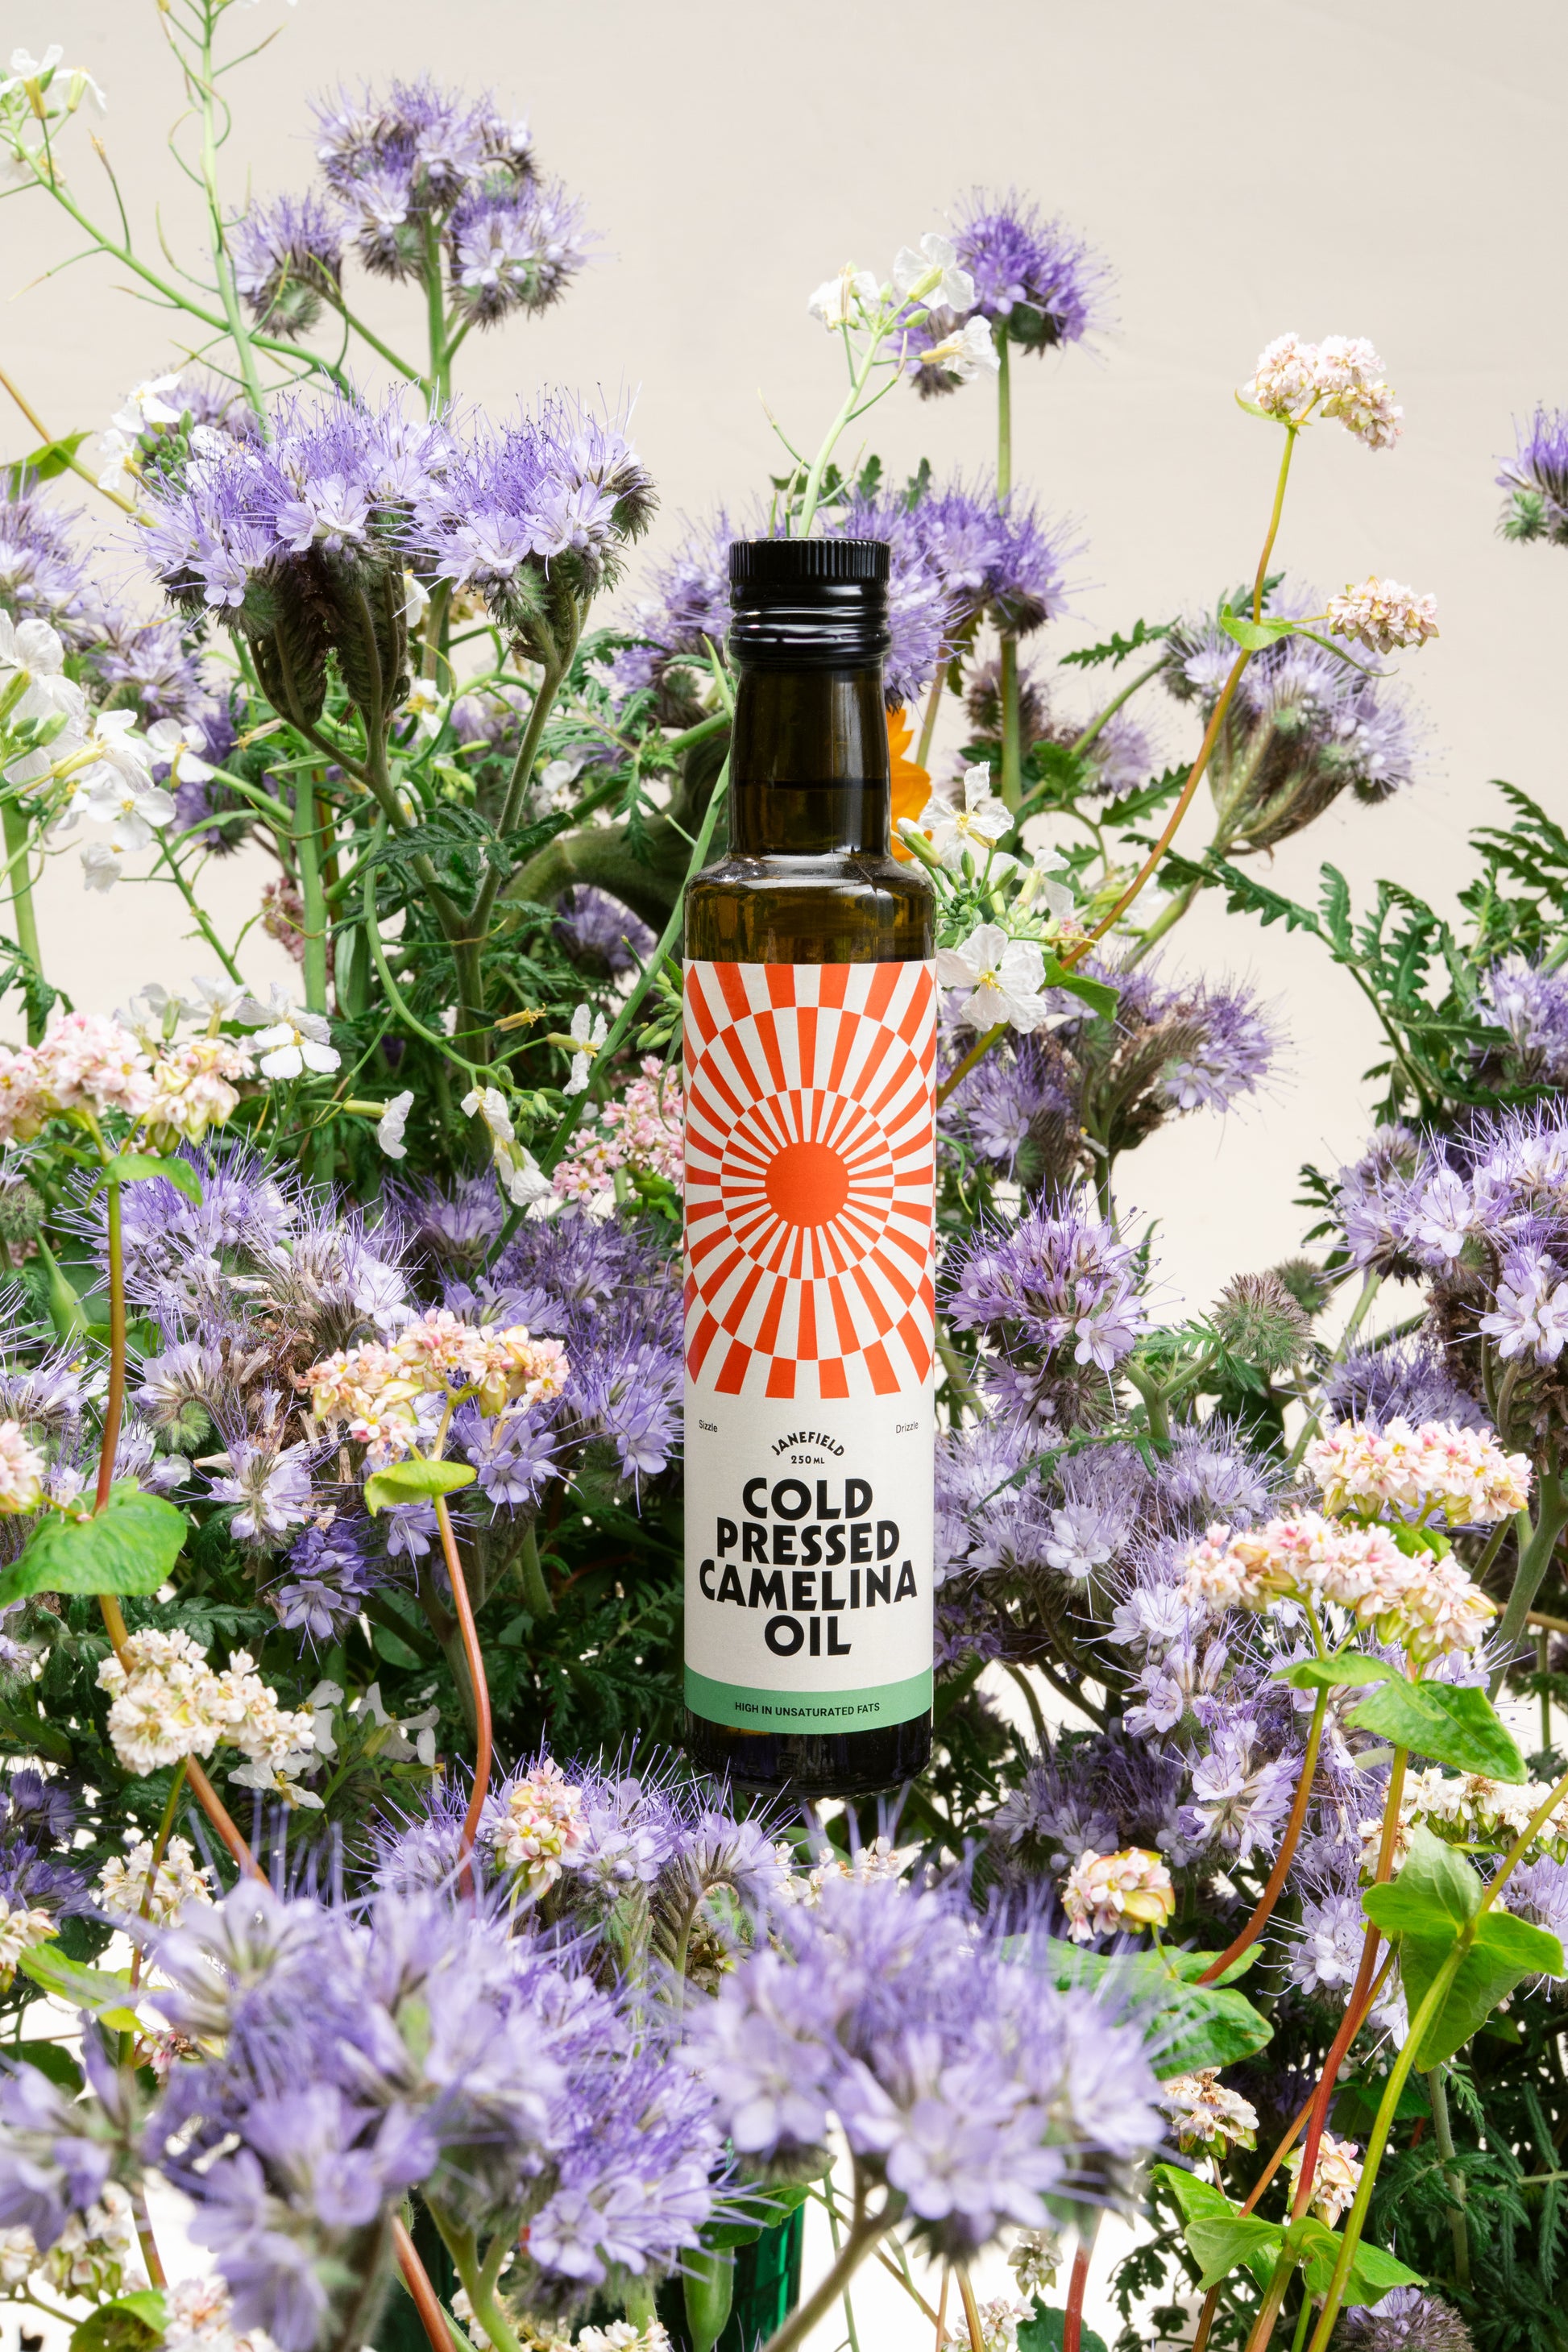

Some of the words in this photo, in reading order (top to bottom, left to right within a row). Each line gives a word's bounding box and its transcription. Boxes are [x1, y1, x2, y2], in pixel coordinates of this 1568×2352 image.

[698, 1419, 718, 1433] Sizzle
[895, 1421, 919, 1434] Drizzle
[771, 1431, 844, 1457] JANEFIELD
[742, 1477, 873, 1520] COLD
[717, 1517, 899, 1566] PRESSED
[699, 1559, 918, 1611] CAMELINA
[765, 1615, 852, 1657] OIL
[735, 1701, 759, 1714] HIGH
[761, 1705, 772, 1715] IN
[775, 1706, 854, 1717] UNSATURATED
[857, 1703, 881, 1714] FATS
